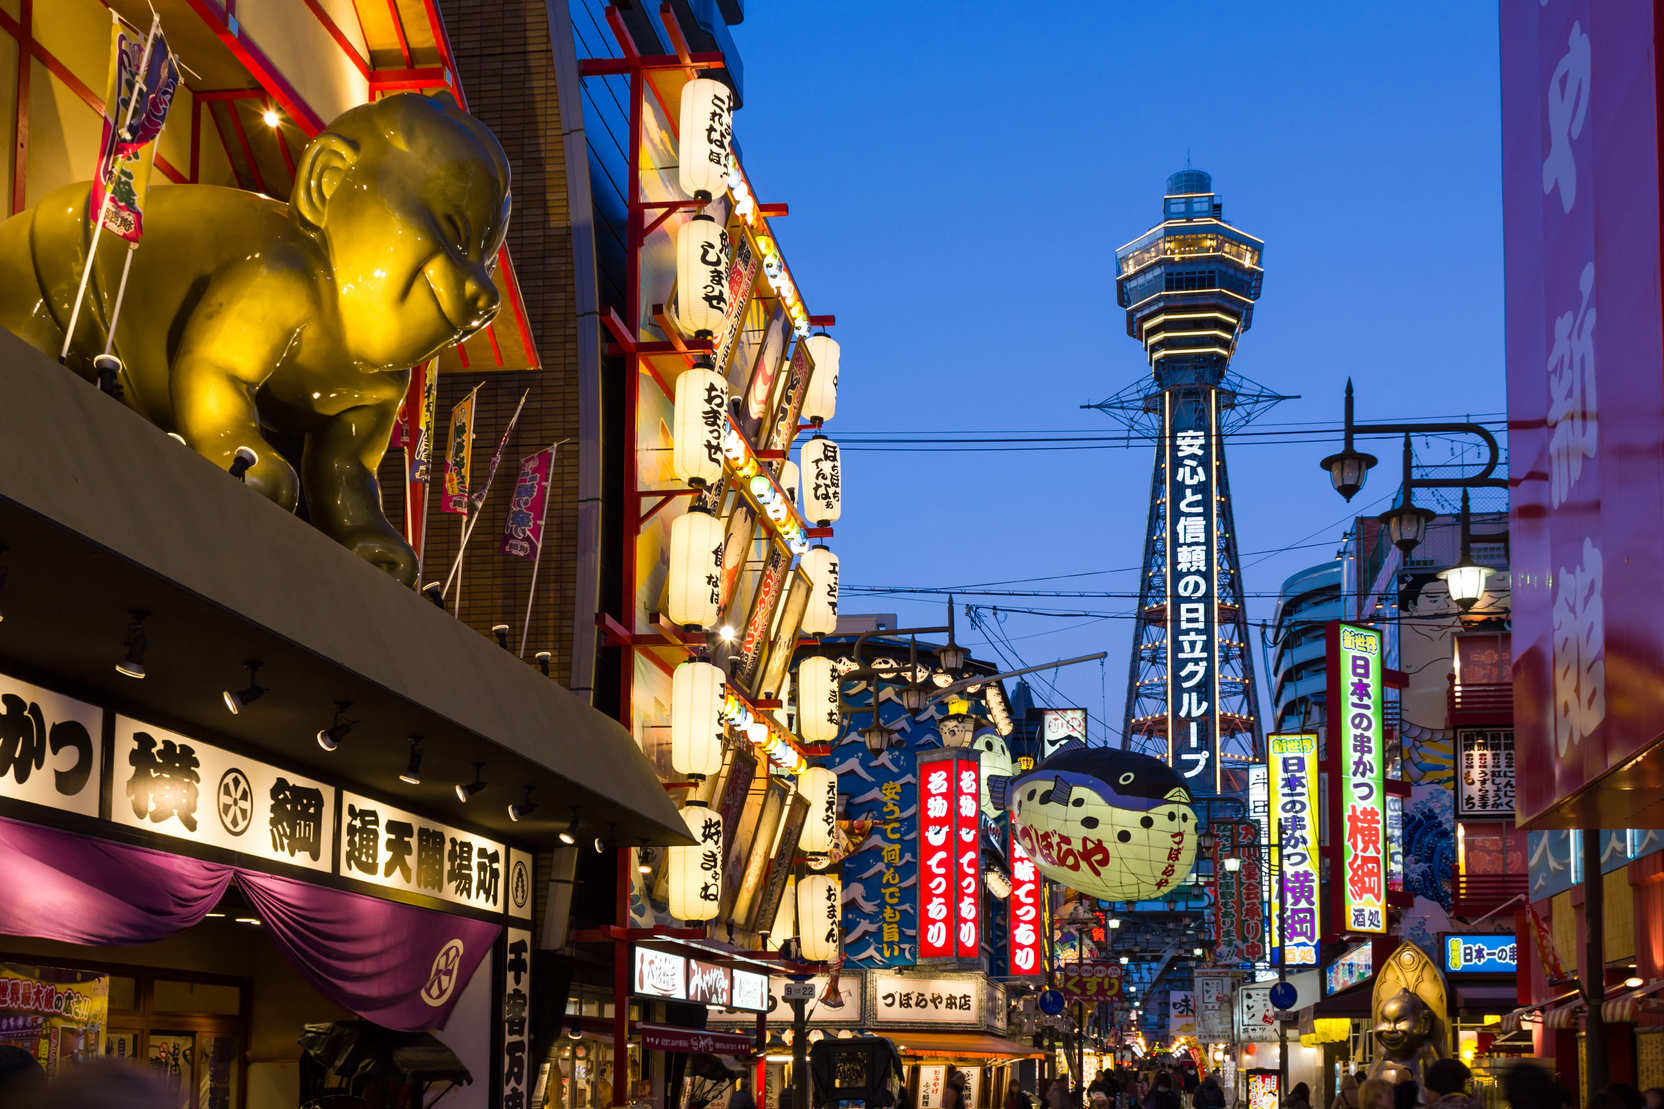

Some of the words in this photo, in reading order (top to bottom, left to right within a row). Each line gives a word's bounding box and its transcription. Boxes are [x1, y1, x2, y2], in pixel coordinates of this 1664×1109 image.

[1176, 430, 1210, 778] 安心と信頼の日立グループ
[1342, 630, 1378, 654] 新世界
[1272, 738, 1314, 754] 新世界
[1348, 655, 1377, 801] 日本一の串かつ
[1281, 756, 1308, 867] 日本一の串かつ
[1346, 804, 1382, 904] 横綱
[926, 851, 948, 948] てっちり
[959, 851, 977, 948] てっちり
[1352, 909, 1382, 929] 酒処
[882, 991, 972, 1012] づぼらや本店
[1066, 975, 1119, 996] くすり
